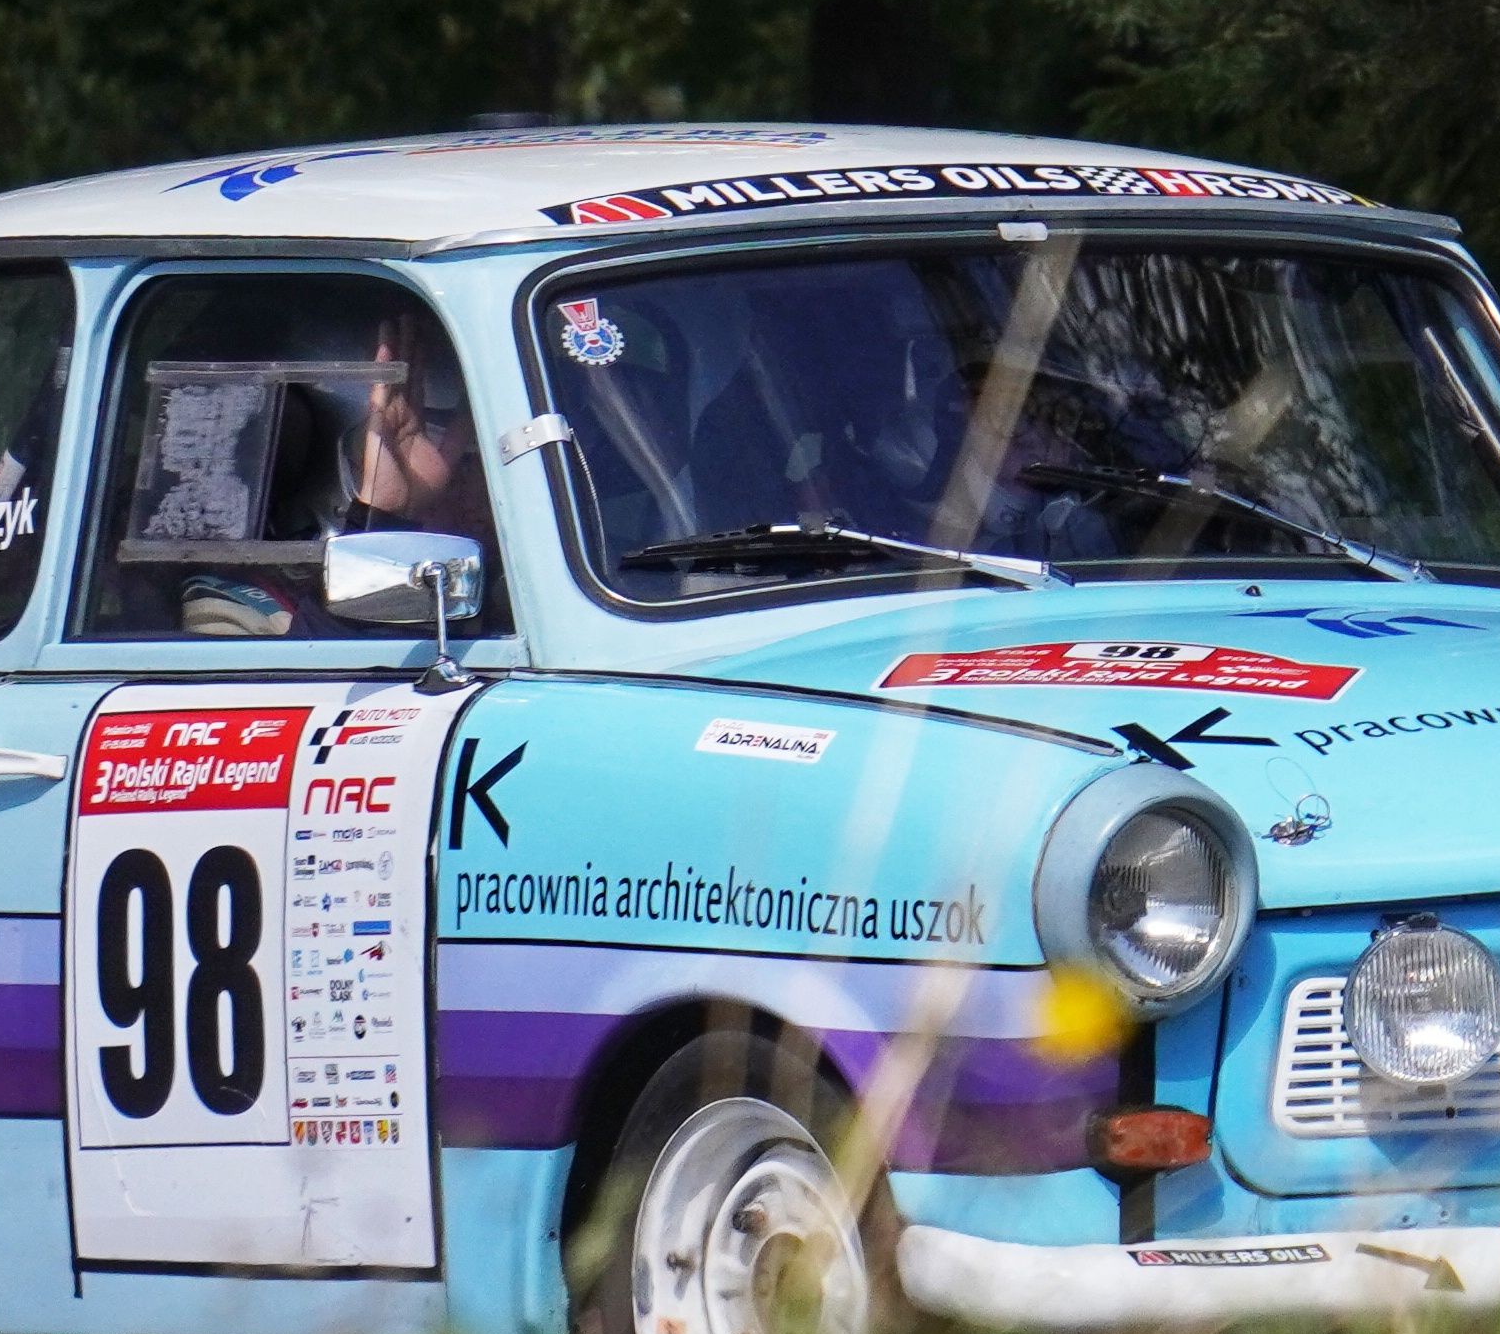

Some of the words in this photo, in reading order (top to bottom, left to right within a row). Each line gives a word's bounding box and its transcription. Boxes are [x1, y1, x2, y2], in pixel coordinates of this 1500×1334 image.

[664, 167, 935, 211] MILLERS
[941, 166, 1080, 190] OILS
[1062, 660, 1185, 670] NAC
[1099, 645, 1181, 659] 98
[917, 668, 960, 682] 3
[962, 668, 1077, 680] Polski
[1082, 669, 1170, 682] Rajd
[1170, 672, 1308, 689] Legend
[162, 722, 227, 747] NAC
[716, 732, 820, 754] ADRENALINA
[91, 760, 113, 804] 3
[112, 757, 172, 788] Polski
[170, 755, 215, 792] Rajd
[212, 754, 285, 792] Legend
[448, 738, 529, 850] K
[304, 777, 396, 815] NAC
[456, 861, 608, 930] pracownia
[617, 861, 879, 940] architektoniczna
[890, 884, 986, 945] uszok
[97, 845, 265, 1119] 98
[1171, 1249, 1270, 1265] MILLERS
[1272, 1244, 1326, 1263] OILS
